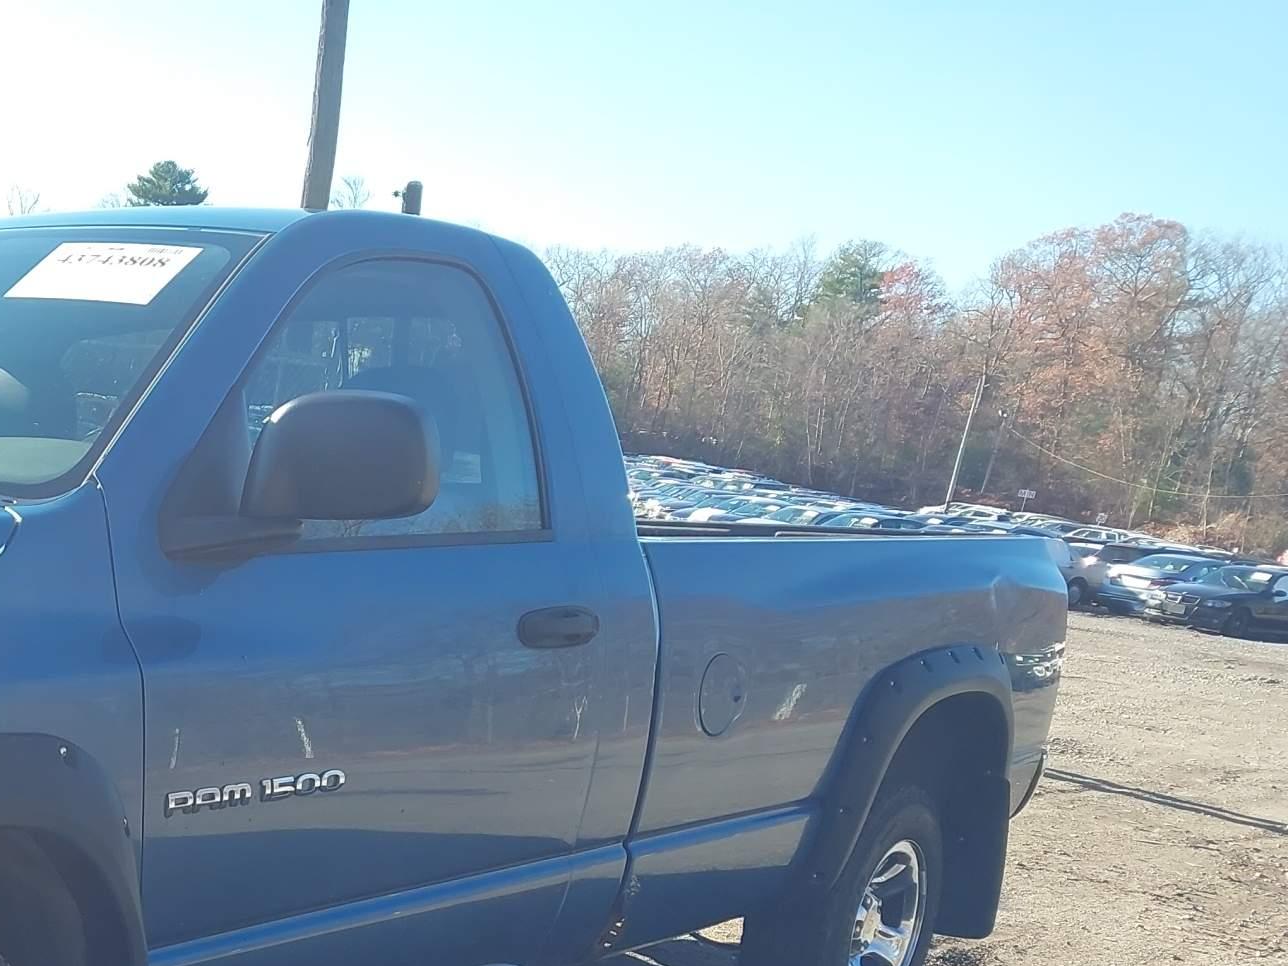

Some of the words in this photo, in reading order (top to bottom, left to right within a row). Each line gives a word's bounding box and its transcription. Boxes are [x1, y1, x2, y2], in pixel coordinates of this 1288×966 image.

[57, 253, 171, 268] 43743808
[165, 782, 253, 817] RAM
[260, 769, 346, 802] 1500
